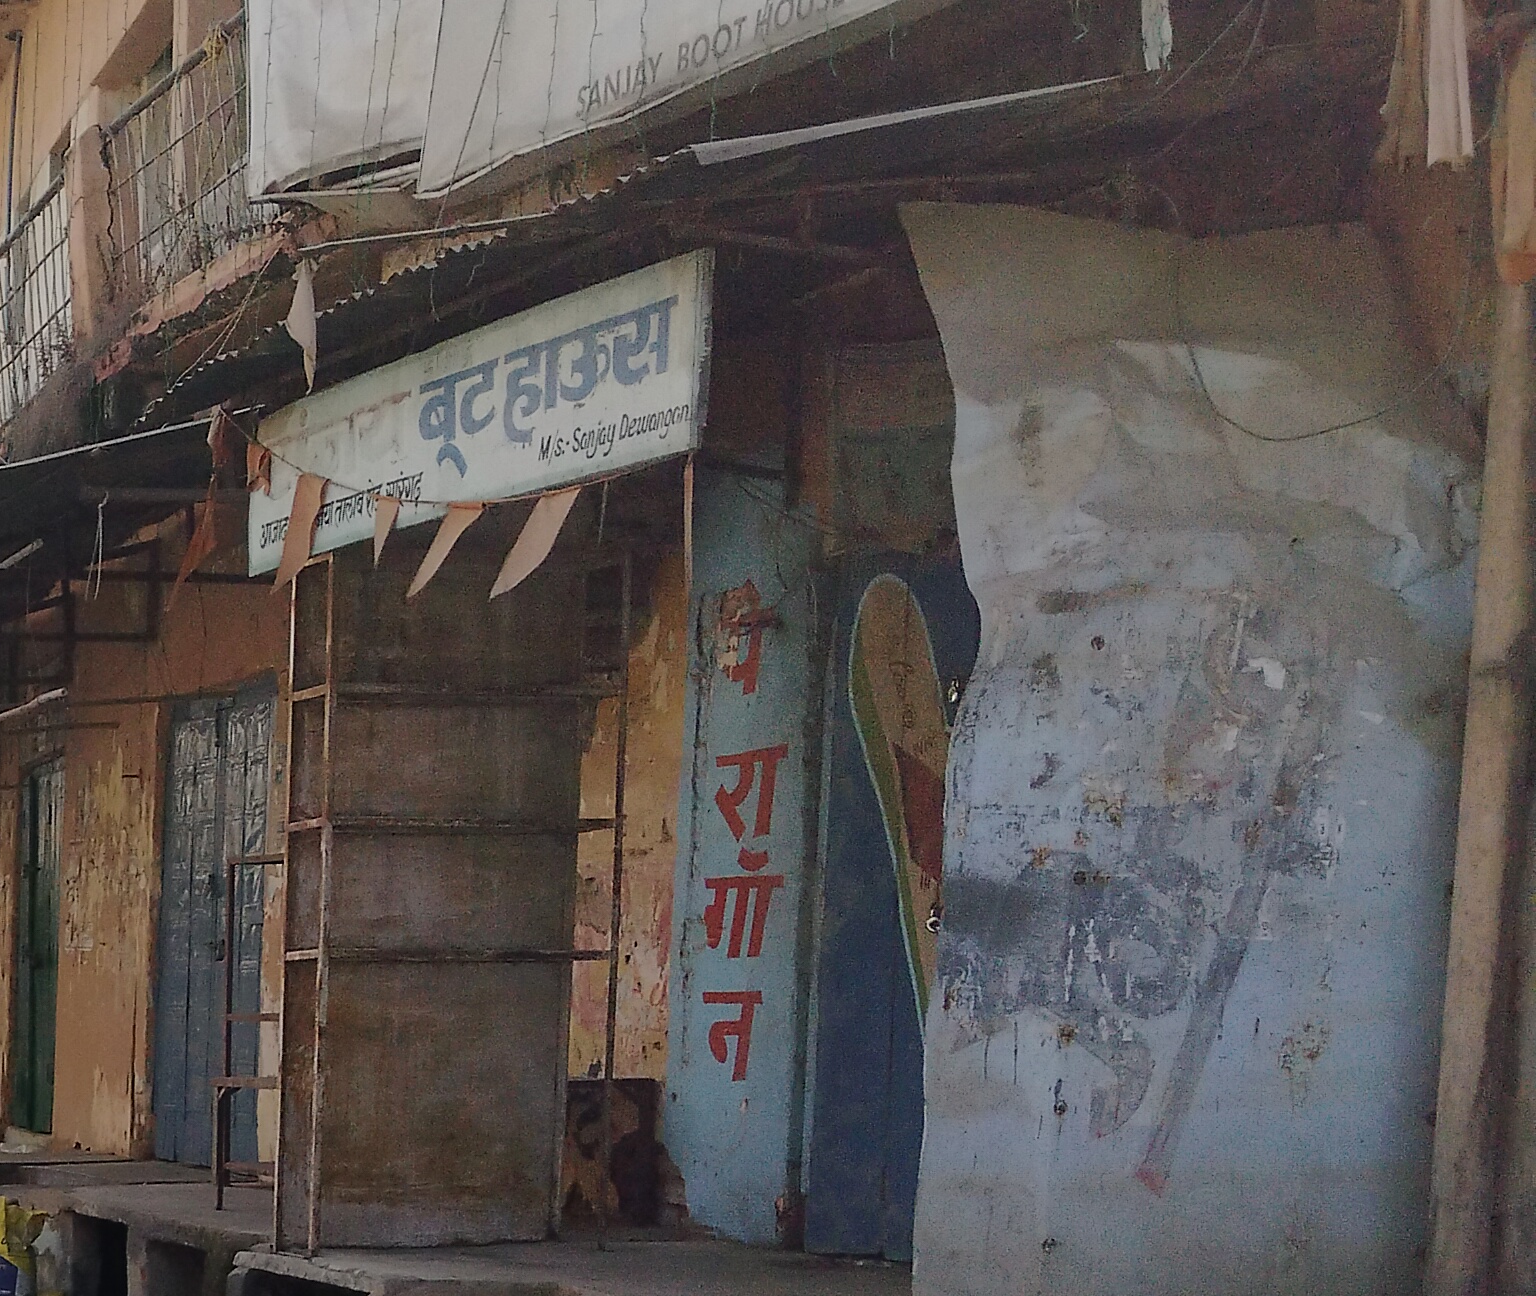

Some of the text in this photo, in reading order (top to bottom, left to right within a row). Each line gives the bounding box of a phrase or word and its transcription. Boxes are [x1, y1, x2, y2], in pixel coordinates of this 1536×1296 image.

[577, 53, 663, 118] SANJAY
[678, 16, 747, 71] BOOT
[573, 420, 616, 460] Sanjay
[618, 403, 691, 440] Dewangan
